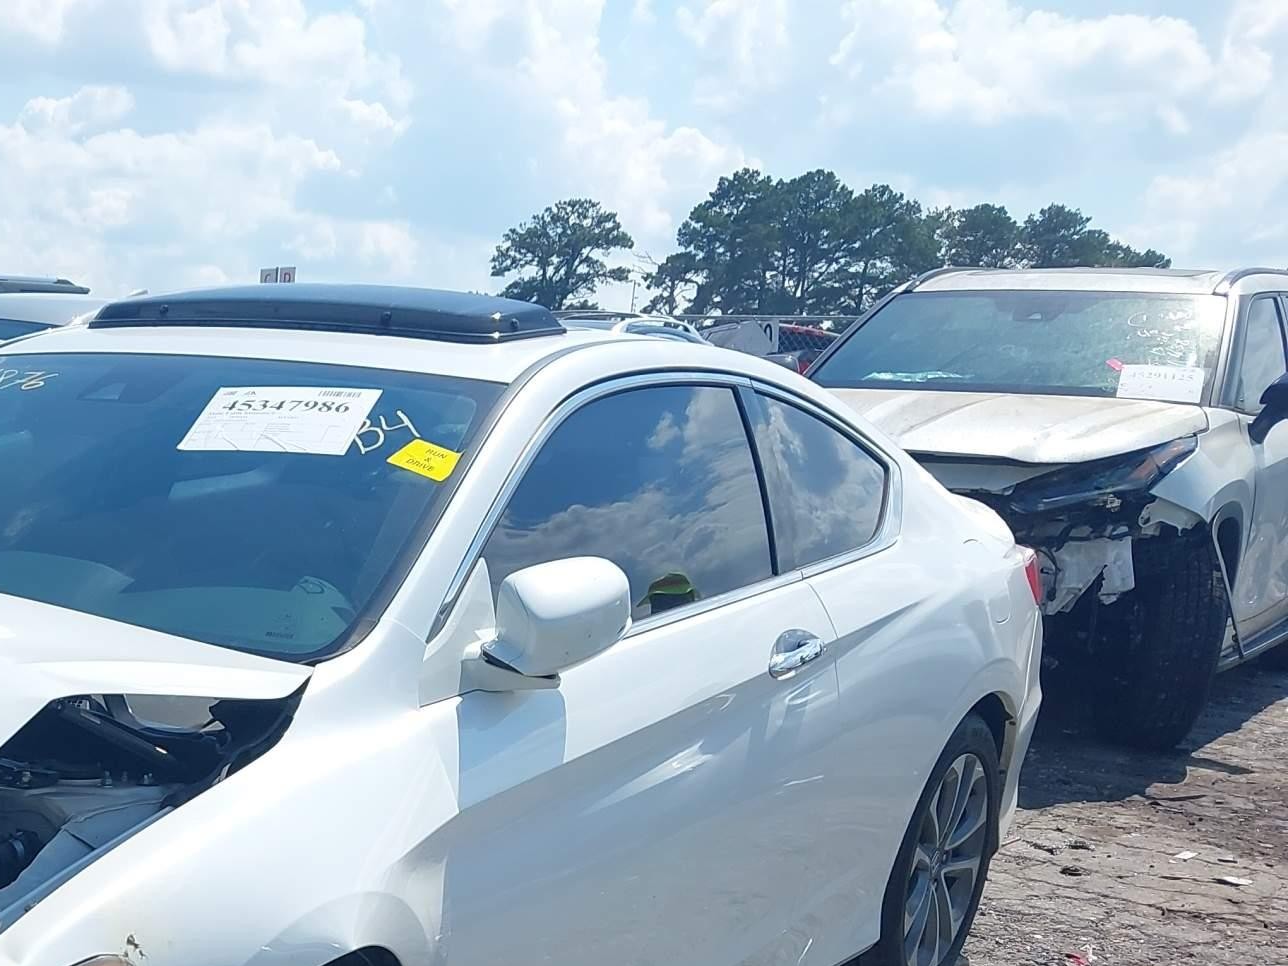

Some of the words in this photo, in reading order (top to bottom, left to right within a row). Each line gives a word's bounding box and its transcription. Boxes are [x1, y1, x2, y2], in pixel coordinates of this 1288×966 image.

[222, 399, 350, 414] 45347986
[425, 448, 448, 459] RUN
[406, 458, 435, 472] DRIVE
